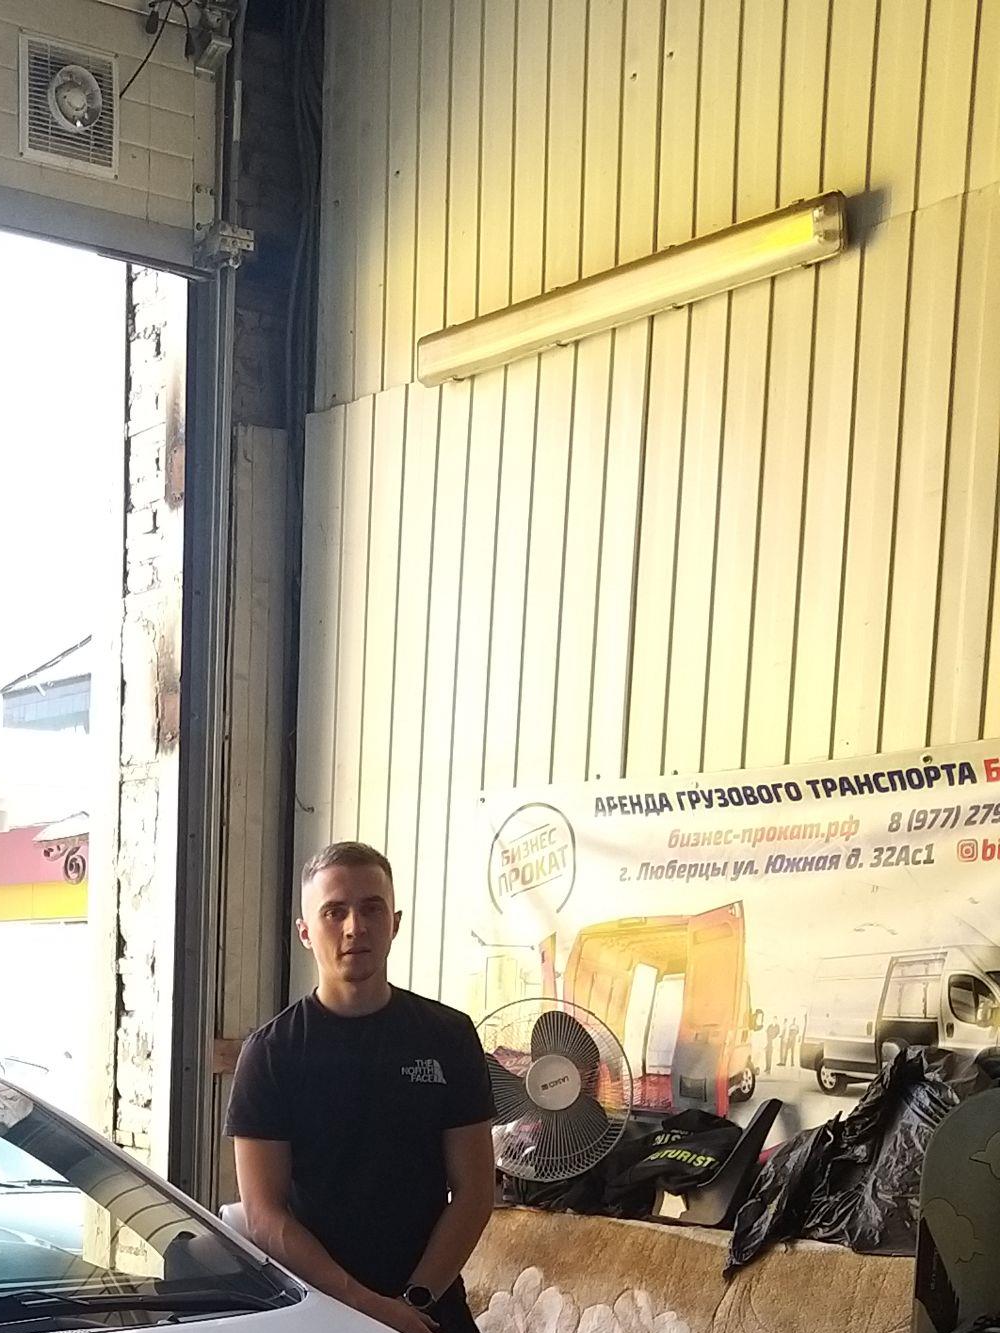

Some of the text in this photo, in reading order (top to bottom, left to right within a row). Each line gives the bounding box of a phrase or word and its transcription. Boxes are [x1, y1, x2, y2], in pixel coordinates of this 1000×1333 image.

[594, 792, 673, 818] АРЕНДА
[676, 781, 803, 812] ГРУЗОВОГО
[806, 761, 977, 799] ТРАНСПОРТА
[668, 815, 860, 848] бизнес-прокат.рф
[888, 812, 903, 833] 8
[907, 805, 962, 833] (977)
[501, 827, 557, 867] БИЗНЕС
[498, 844, 568, 896] ПРОКАТ
[619, 866, 631, 882] г.
[636, 860, 728, 883] Люберцы
[731, 859, 759, 882] ул.
[764, 854, 841, 875] Южная
[846, 848, 864, 870] д.
[401, 1066, 433, 1075] NORTH
[411, 1074, 434, 1083] FACE
[415, 1059, 433, 1067] THE
